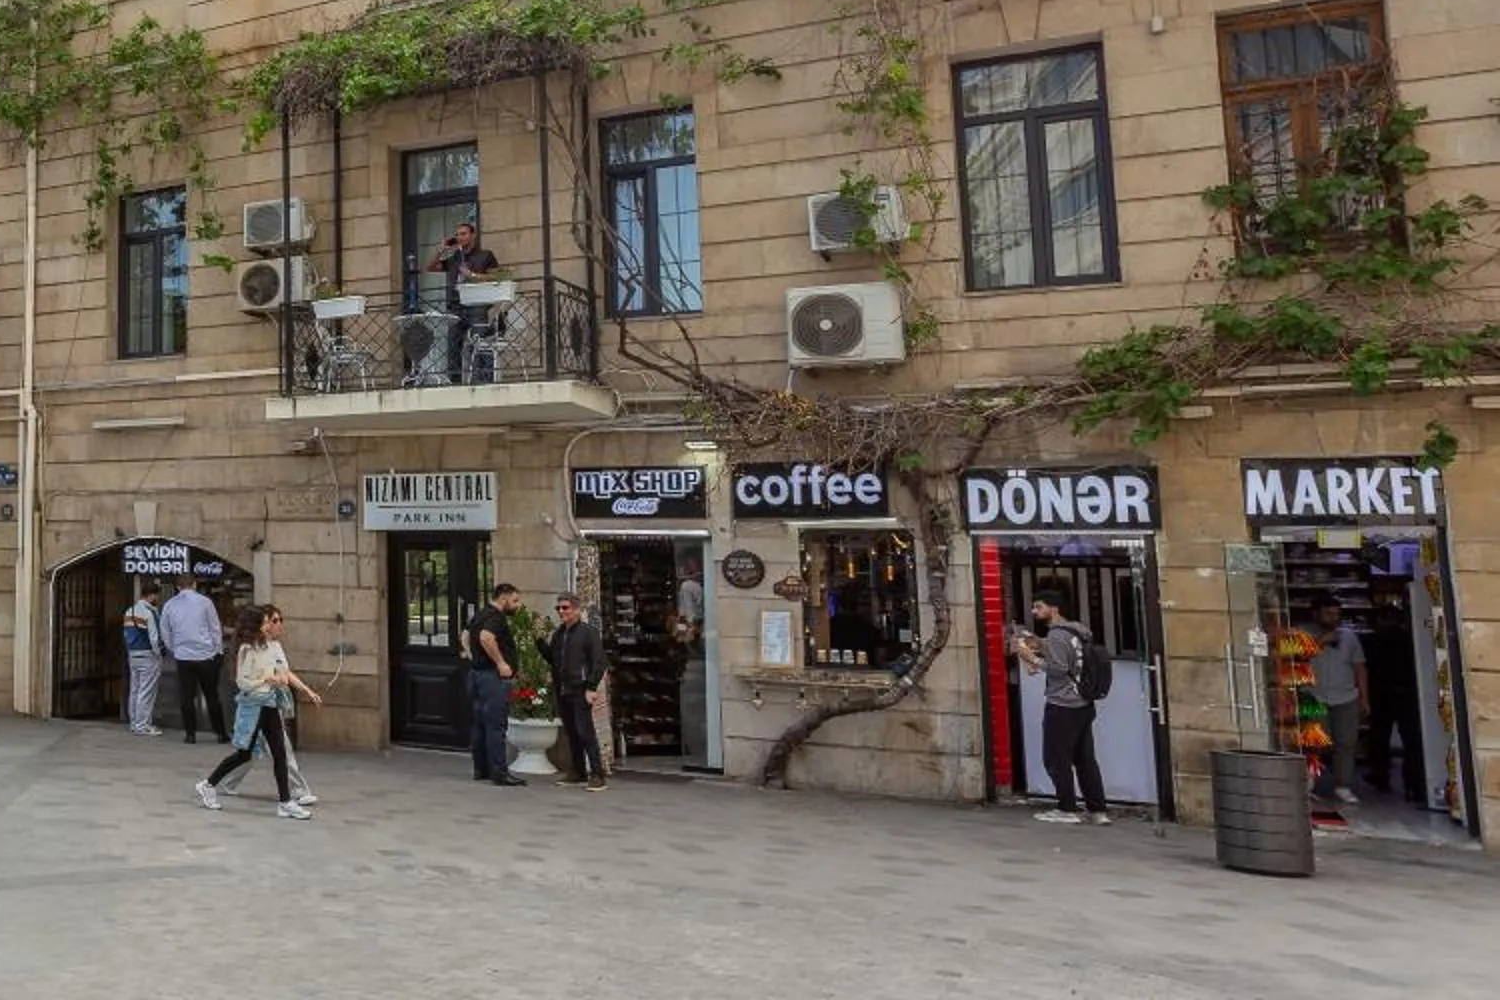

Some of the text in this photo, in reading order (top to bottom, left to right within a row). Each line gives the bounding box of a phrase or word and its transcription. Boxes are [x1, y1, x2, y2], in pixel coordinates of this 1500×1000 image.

[425, 474, 493, 501] CENTRAL
[633, 468, 700, 498] SHOP
[735, 464, 883, 506] coffee
[966, 469, 1152, 525] DÖNƏR
[1246, 467, 1440, 515] MARKET
[393, 512, 466, 524] PARK INN
